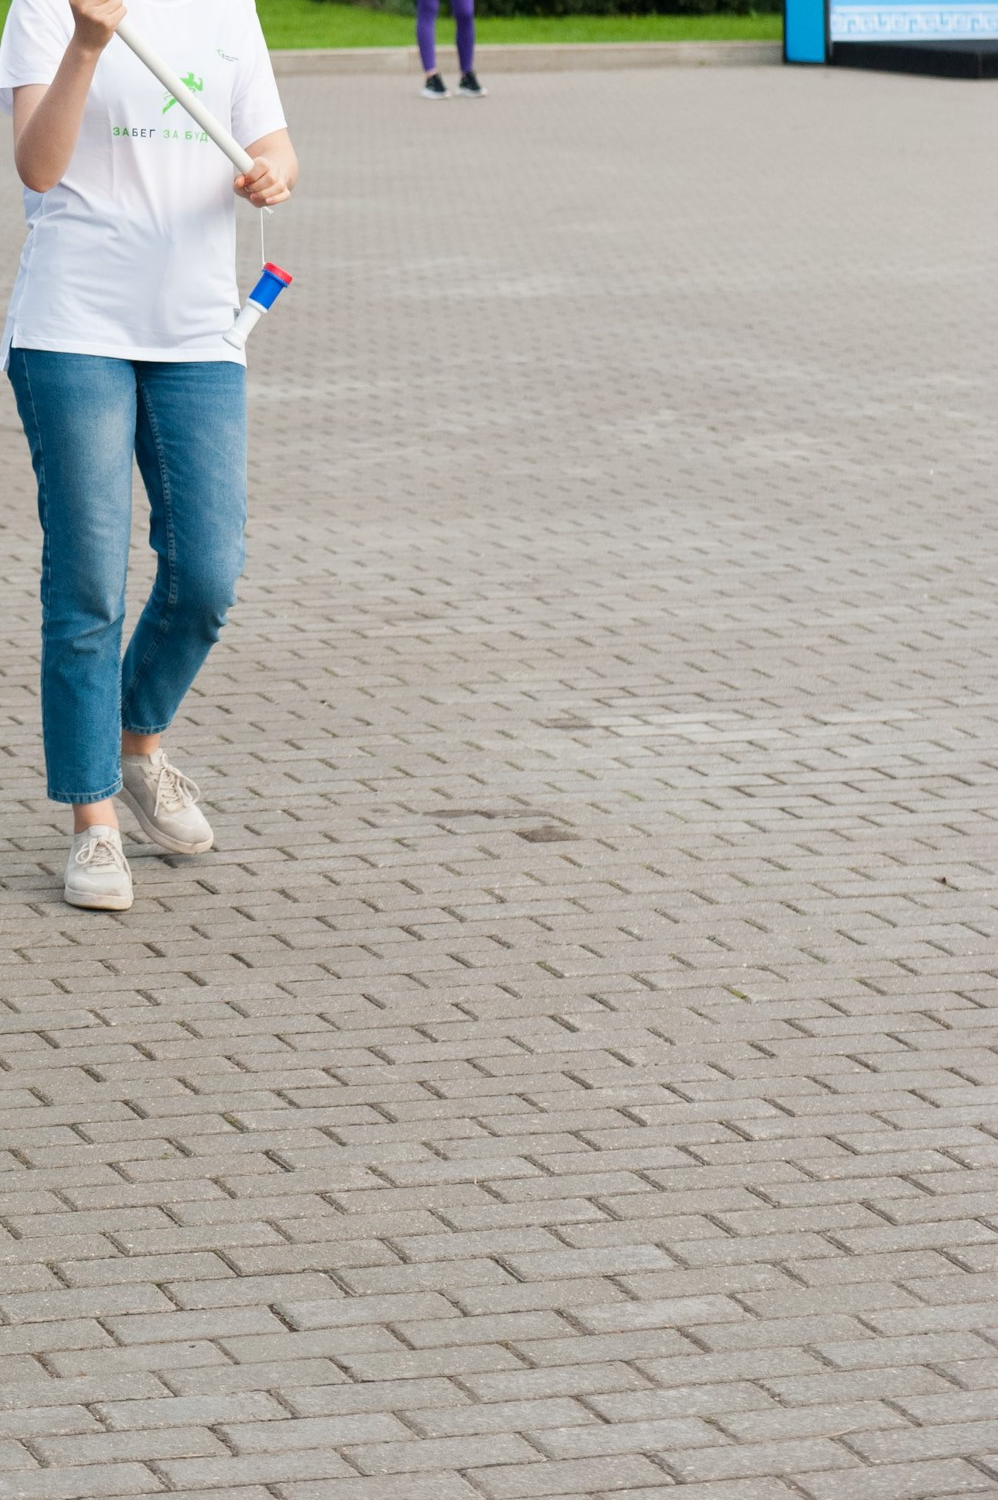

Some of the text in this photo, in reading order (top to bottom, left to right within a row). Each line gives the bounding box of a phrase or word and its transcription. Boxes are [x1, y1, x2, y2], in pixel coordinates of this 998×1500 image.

[113, 126, 208, 142] ЗАБЕГ ЗА БУД
